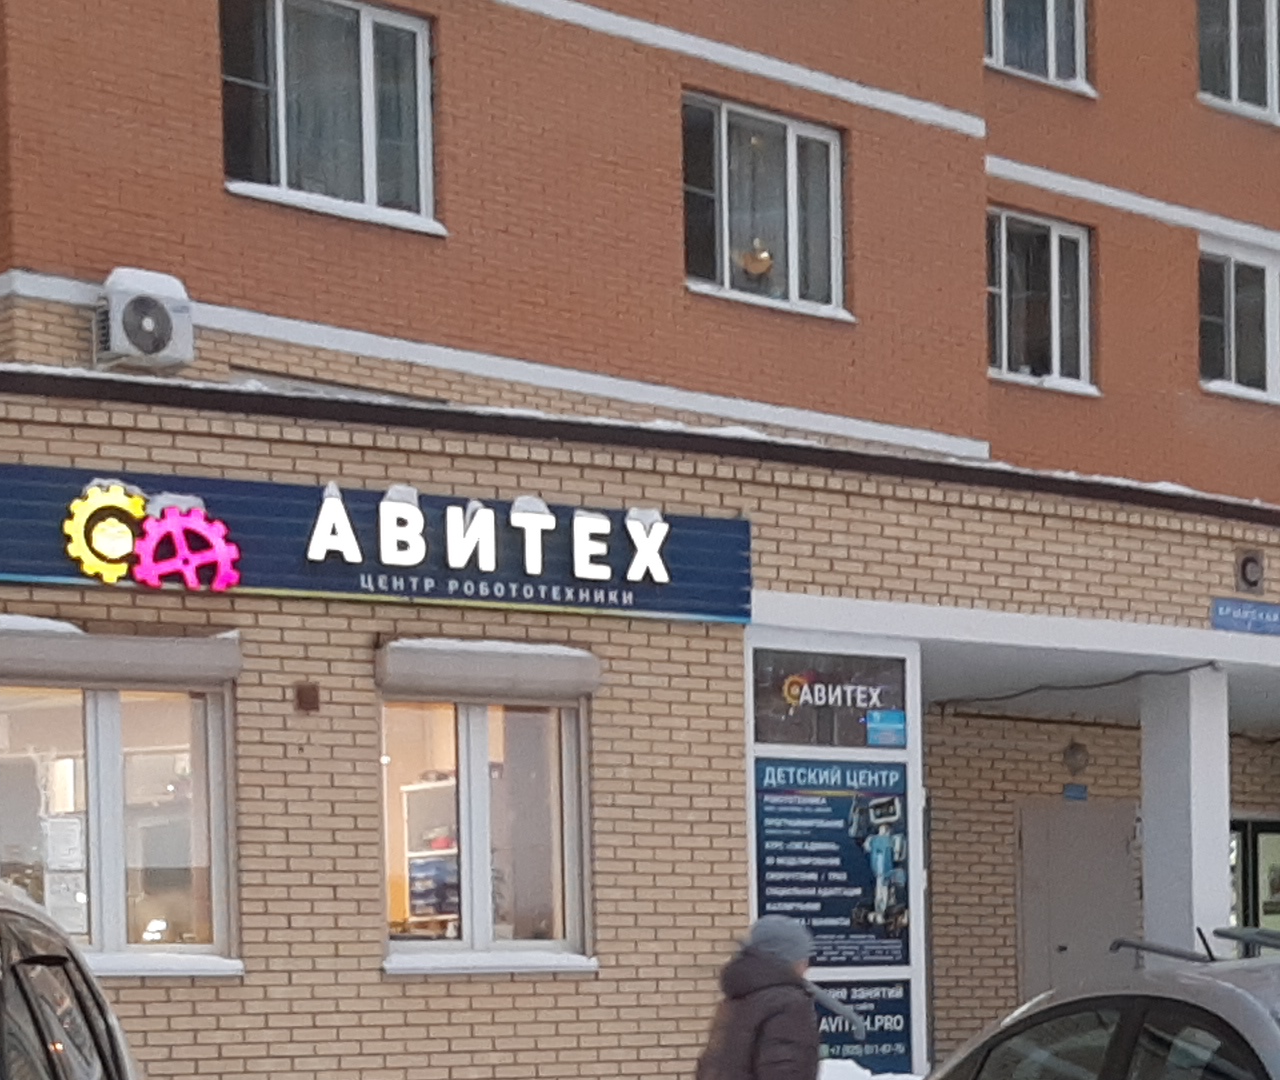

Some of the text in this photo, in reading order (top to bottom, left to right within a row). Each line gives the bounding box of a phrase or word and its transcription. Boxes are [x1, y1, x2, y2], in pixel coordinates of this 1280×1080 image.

[307, 496, 670, 584] АВИТЕХ
[359, 573, 634, 606] ЦЕНТР РОБОТОТЕХНИКИ
[799, 682, 882, 708] АВИТЕХ
[763, 765, 900, 788] ДЕТСКИЙ ЦЕНТР
